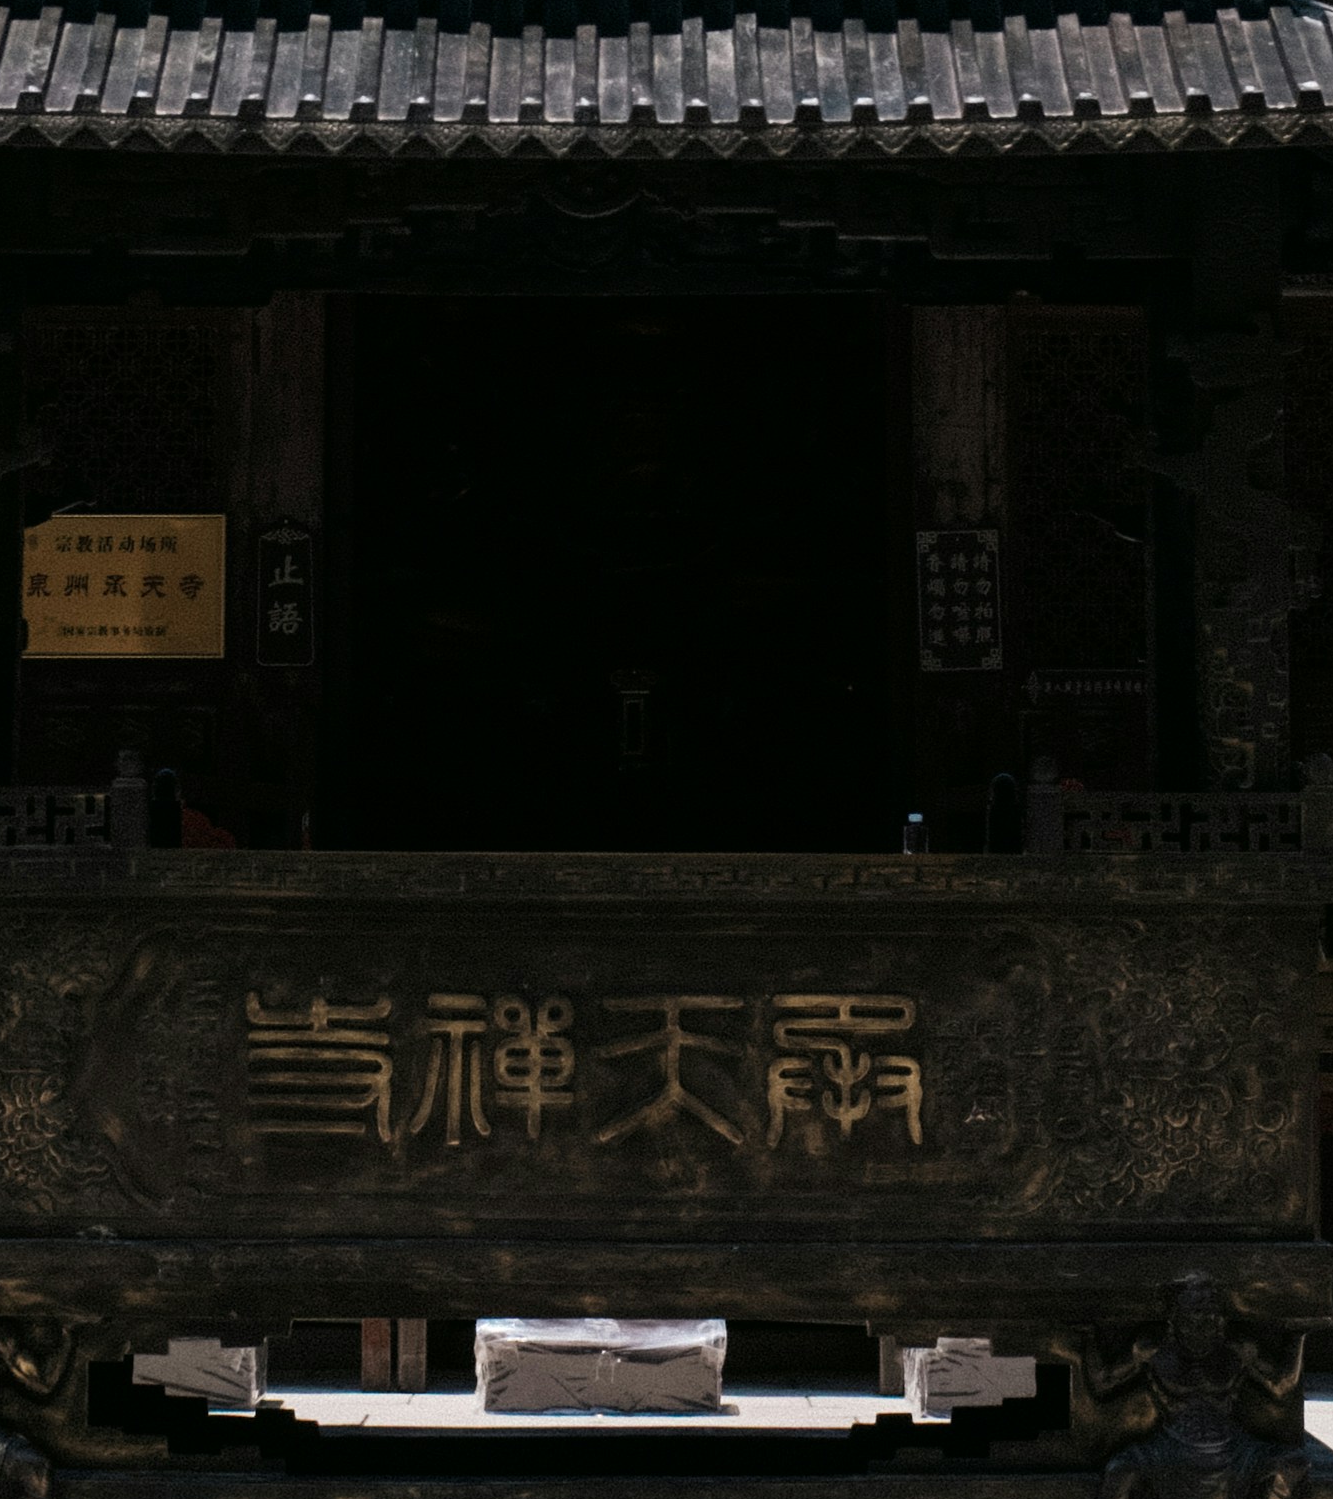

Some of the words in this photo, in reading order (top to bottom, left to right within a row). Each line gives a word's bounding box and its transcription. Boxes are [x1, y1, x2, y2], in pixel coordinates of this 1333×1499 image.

[55, 535, 178, 554] 宗教活动场所
[26, 572, 205, 599] 泉州承天寺
[268, 554, 304, 635] 止語
